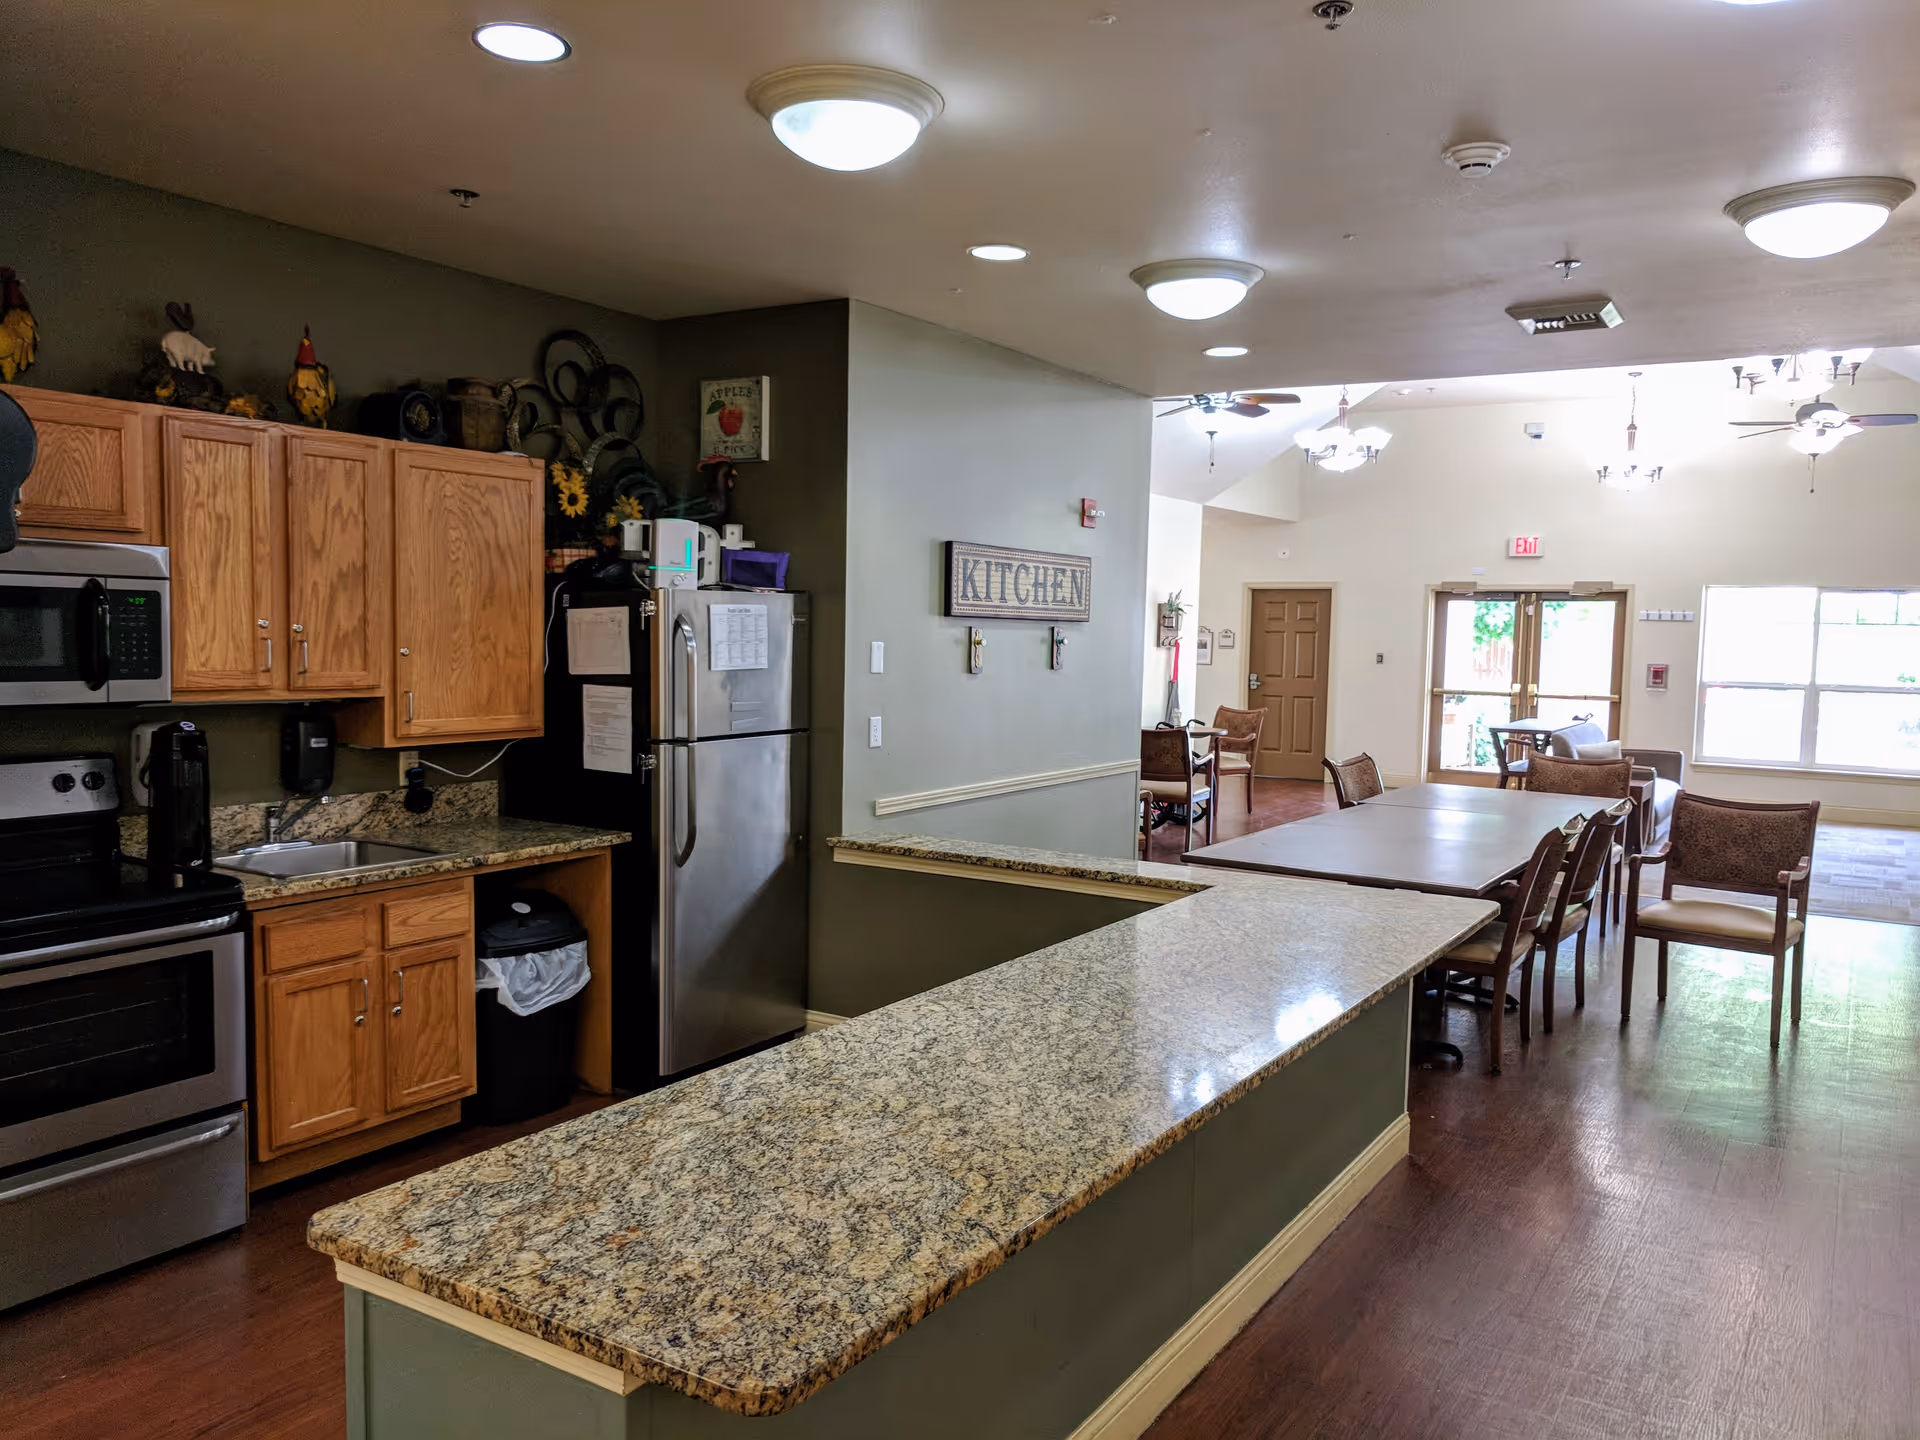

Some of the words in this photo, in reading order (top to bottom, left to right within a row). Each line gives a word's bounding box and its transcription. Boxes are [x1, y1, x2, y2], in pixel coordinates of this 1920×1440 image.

[710, 386, 753, 401] APPLES
[1515, 536, 1539, 554] EXIT
[961, 557, 1085, 607] KITCHEN
